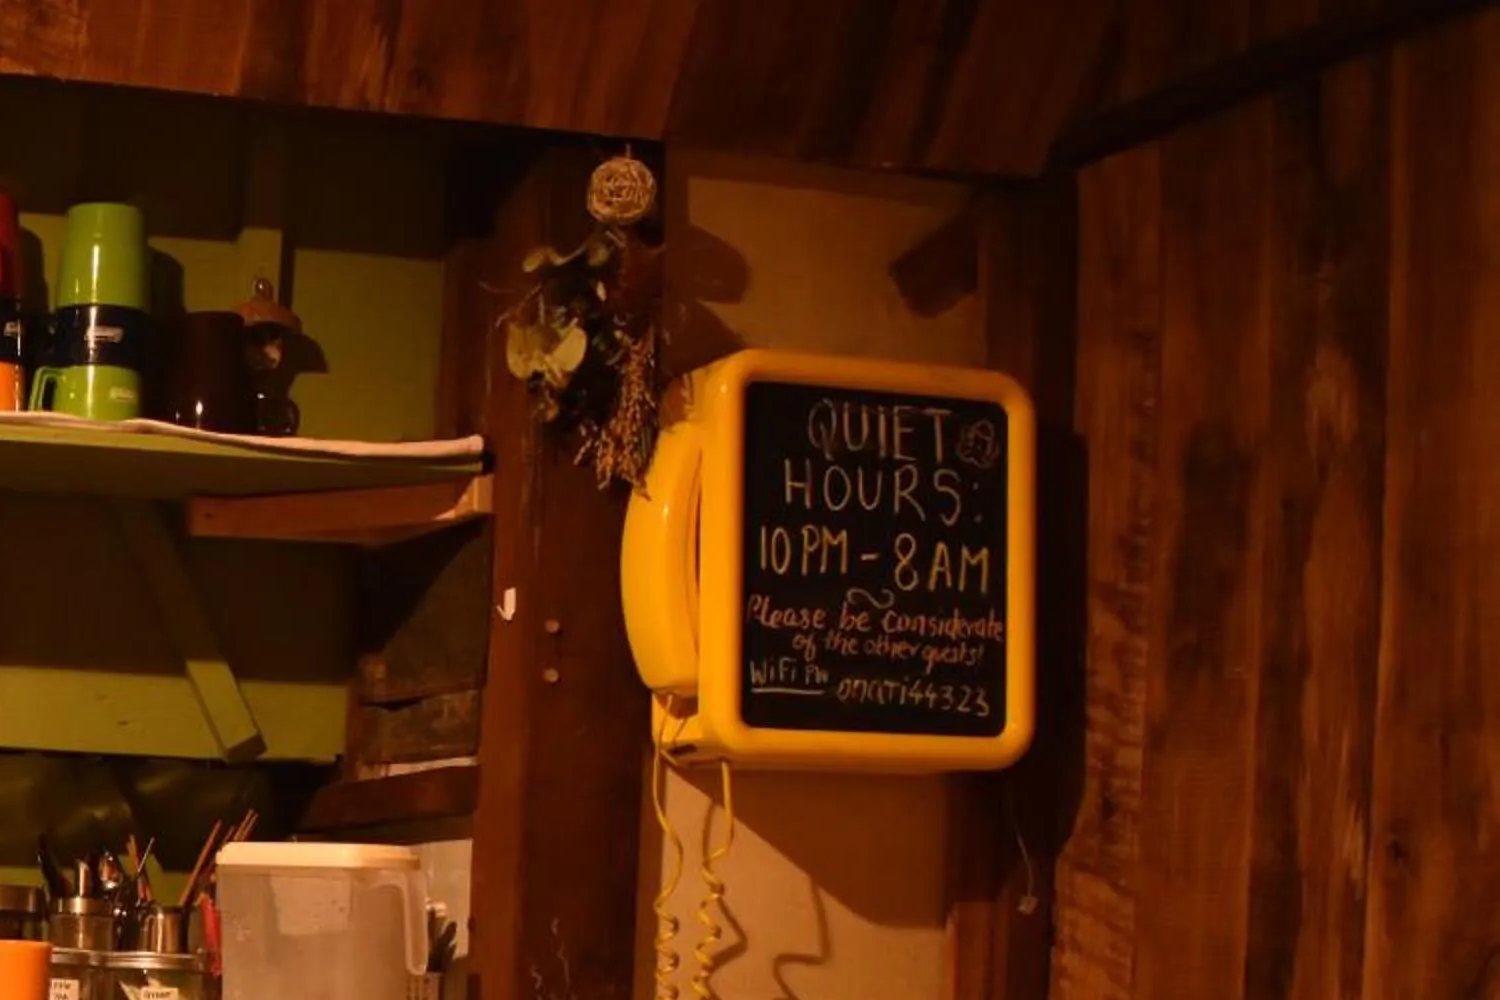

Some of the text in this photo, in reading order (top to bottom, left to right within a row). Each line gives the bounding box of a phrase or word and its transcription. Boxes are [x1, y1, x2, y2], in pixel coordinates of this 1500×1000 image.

[808, 397, 952, 464] QUIET
[784, 458, 983, 527] HOURS:
[747, 594, 826, 629] Please
[838, 600, 873, 632] be
[792, 632, 817, 662] of
[824, 629, 860, 657] the
[863, 634, 920, 660] other
